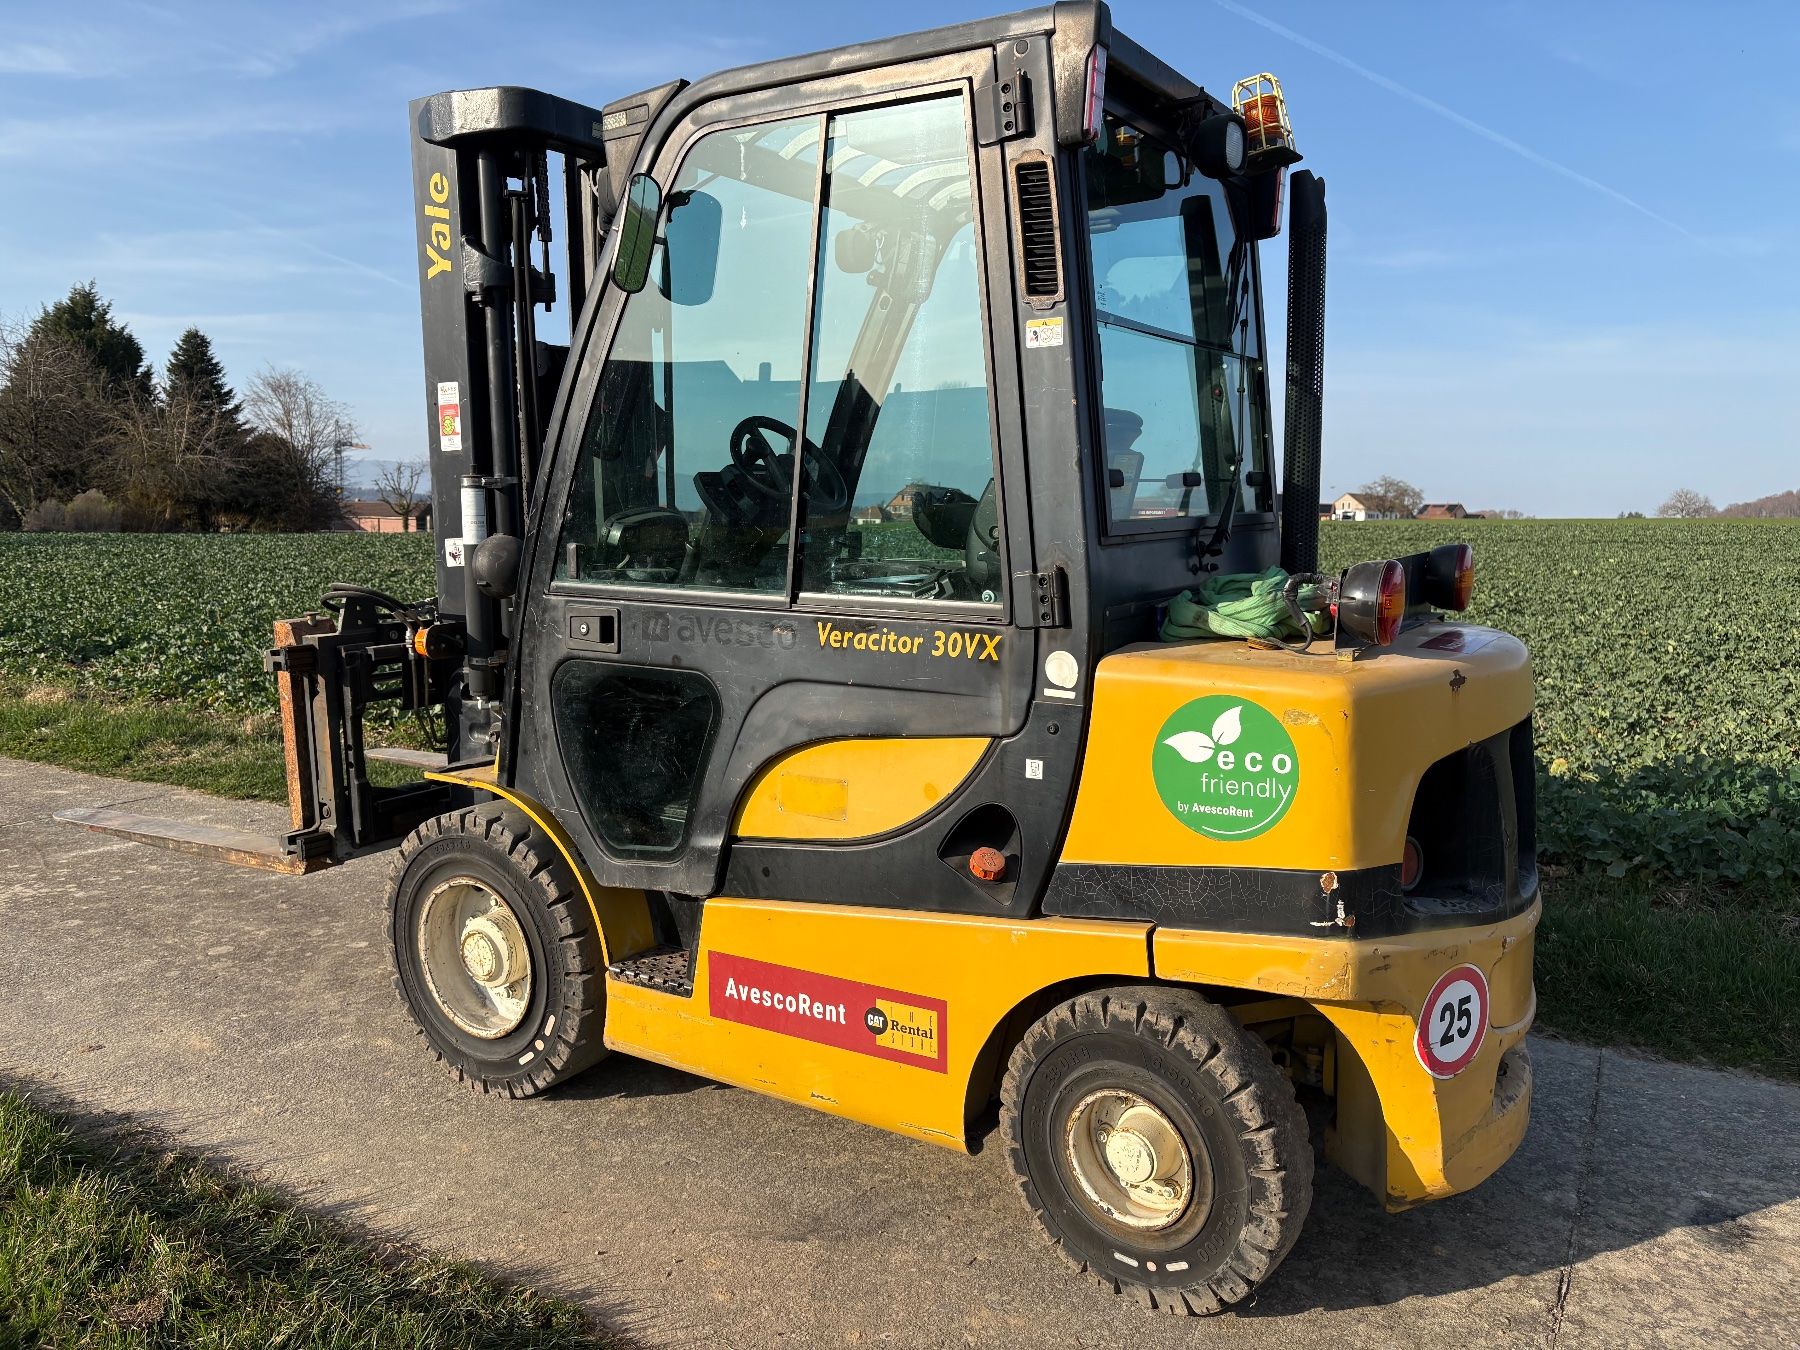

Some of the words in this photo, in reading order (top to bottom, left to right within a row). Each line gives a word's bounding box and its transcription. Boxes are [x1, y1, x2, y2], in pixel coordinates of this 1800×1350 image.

[424, 172, 452, 280] Yale
[817, 621, 924, 655] Veracitor
[931, 630, 1003, 661] 30VX
[1216, 750, 1292, 774] eco
[1200, 772, 1292, 800] friendly
[1177, 801, 1190, 814] by
[1192, 803, 1254, 818] AvescoRent
[725, 977, 847, 1024] AvescoRent
[867, 1014, 885, 1029] CAT
[890, 1019, 934, 1040] Rental
[1439, 994, 1472, 1048] 25
